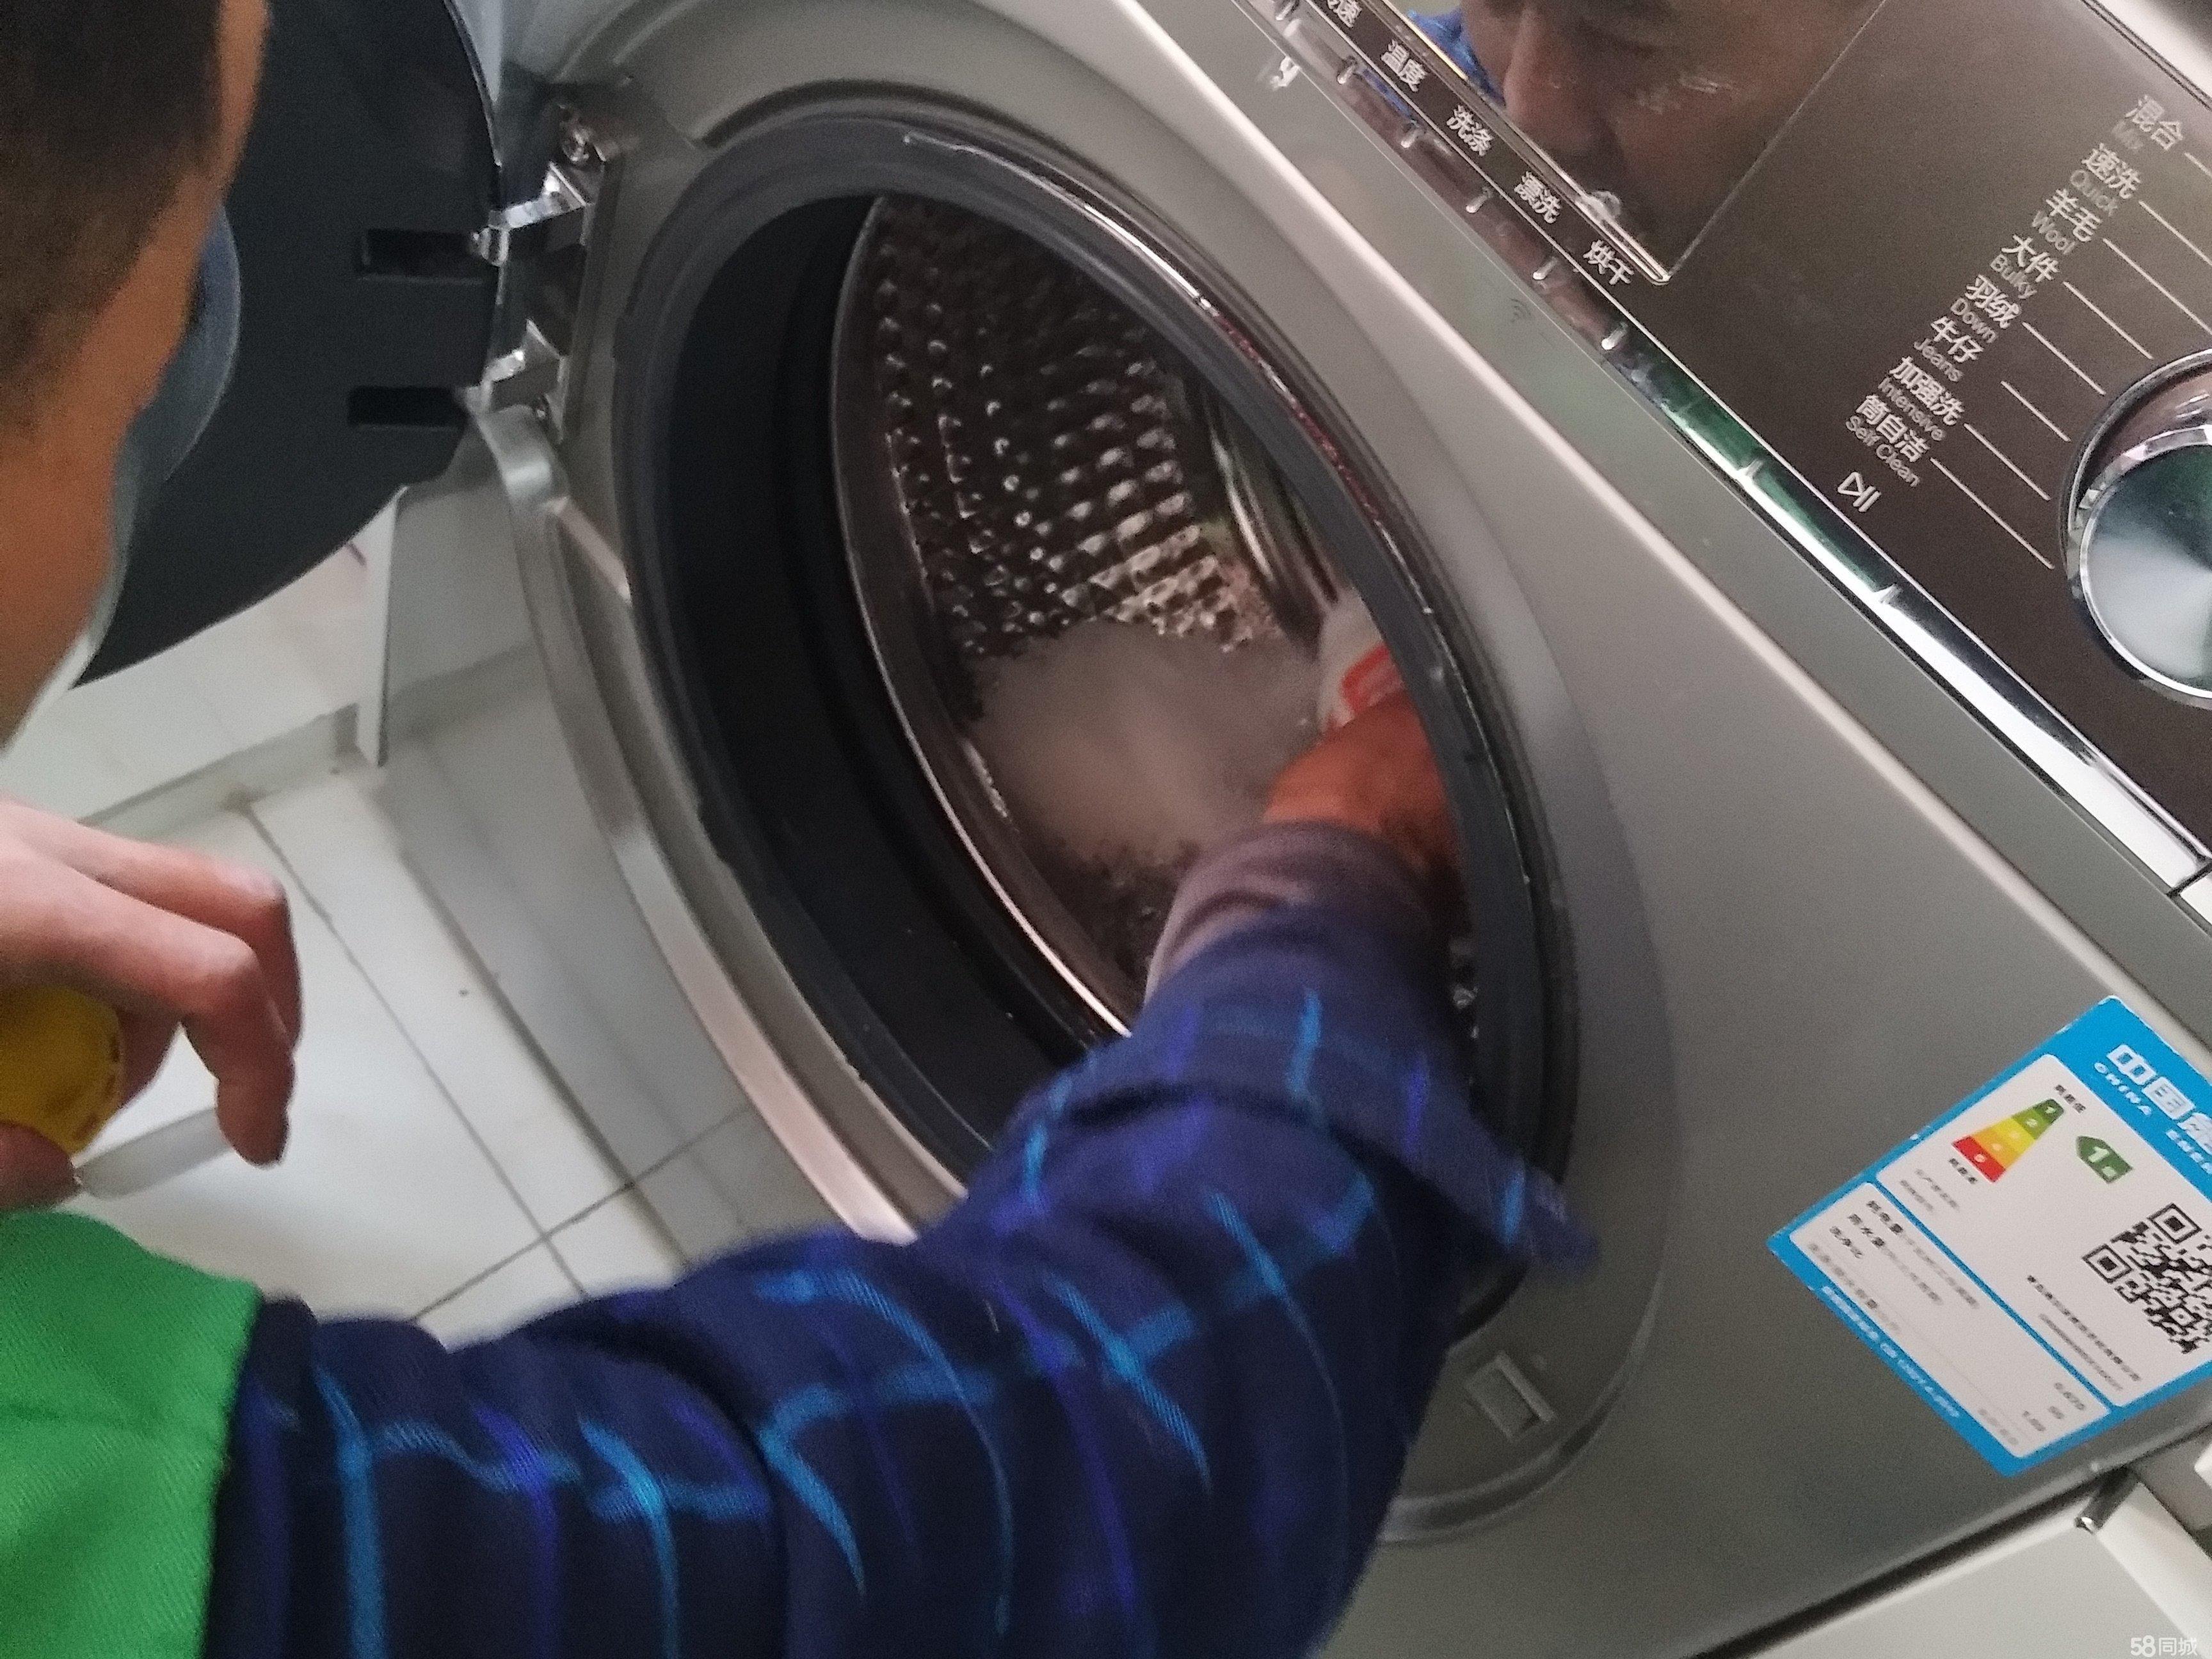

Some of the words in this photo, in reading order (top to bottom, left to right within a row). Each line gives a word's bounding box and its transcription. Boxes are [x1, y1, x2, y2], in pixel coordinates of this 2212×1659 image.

[1381, 39, 1427, 92] 温度
[1447, 104, 1494, 157] 洗涤
[2125, 95, 2183, 150] 混合
[1514, 171, 1562, 223] 漂洗
[2070, 170, 2118, 216] Quick
[2081, 143, 2142, 199] 速洗
[2032, 211, 2076, 255] Wool
[2046, 189, 2103, 242] 羊毛
[1583, 239, 1634, 285] 烘干
[1990, 253, 2038, 299] Bulky
[2001, 234, 2059, 283] 大件
[1950, 298, 1998, 343] Down
[1964, 274, 2022, 329] 羽绒
[1914, 338, 1964, 382] Jeans
[1930, 316, 1984, 363] 牛仔
[1877, 377, 1946, 441] Intensive
[1889, 356, 1965, 426] 加强洗
[1846, 416, 1882, 447] Self
[1876, 444, 1920, 487] Clean
[1855, 394, 1931, 463] 筒自洁
